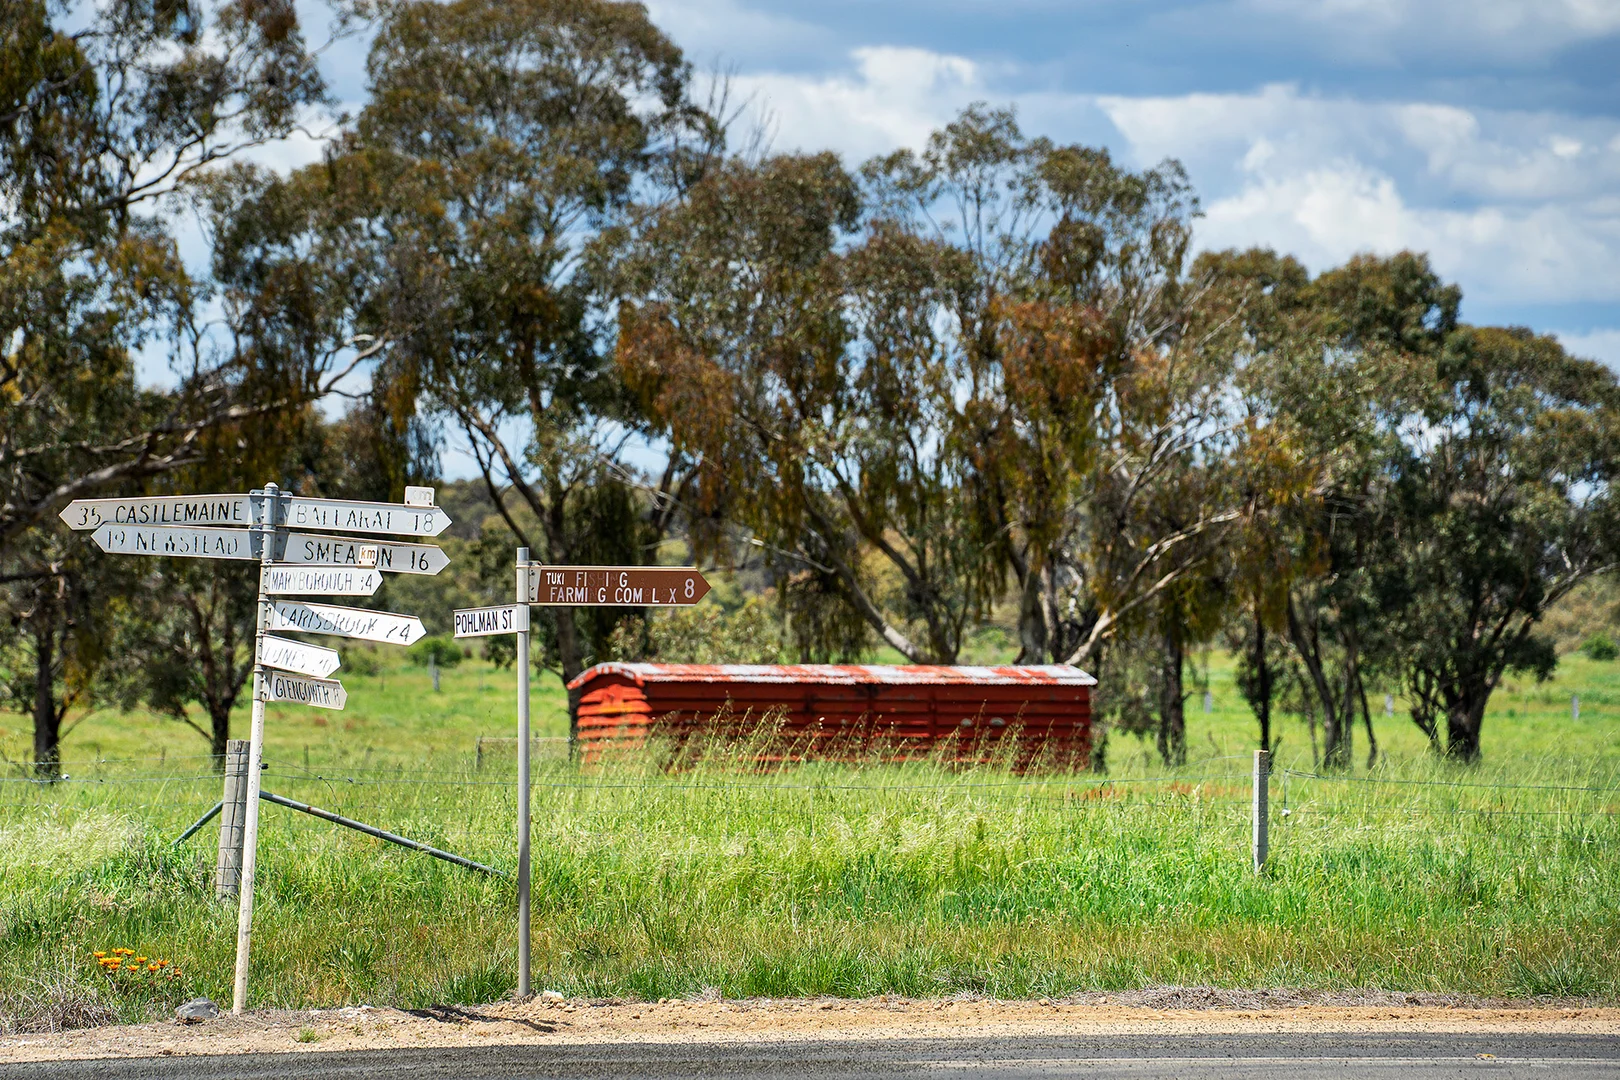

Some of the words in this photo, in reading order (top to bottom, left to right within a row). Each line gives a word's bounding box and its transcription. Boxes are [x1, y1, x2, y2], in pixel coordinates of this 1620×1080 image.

[115, 501, 243, 523] CASTLEMAINE
[413, 512, 434, 533] 18
[304, 541, 393, 567] SMEAN
[411, 550, 429, 571] 16
[361, 547, 376, 560] km
[546, 572, 565, 585] TUKI
[684, 578, 695, 598] 8
[456, 610, 499, 634] POHLMAN
[502, 609, 513, 630] ST
